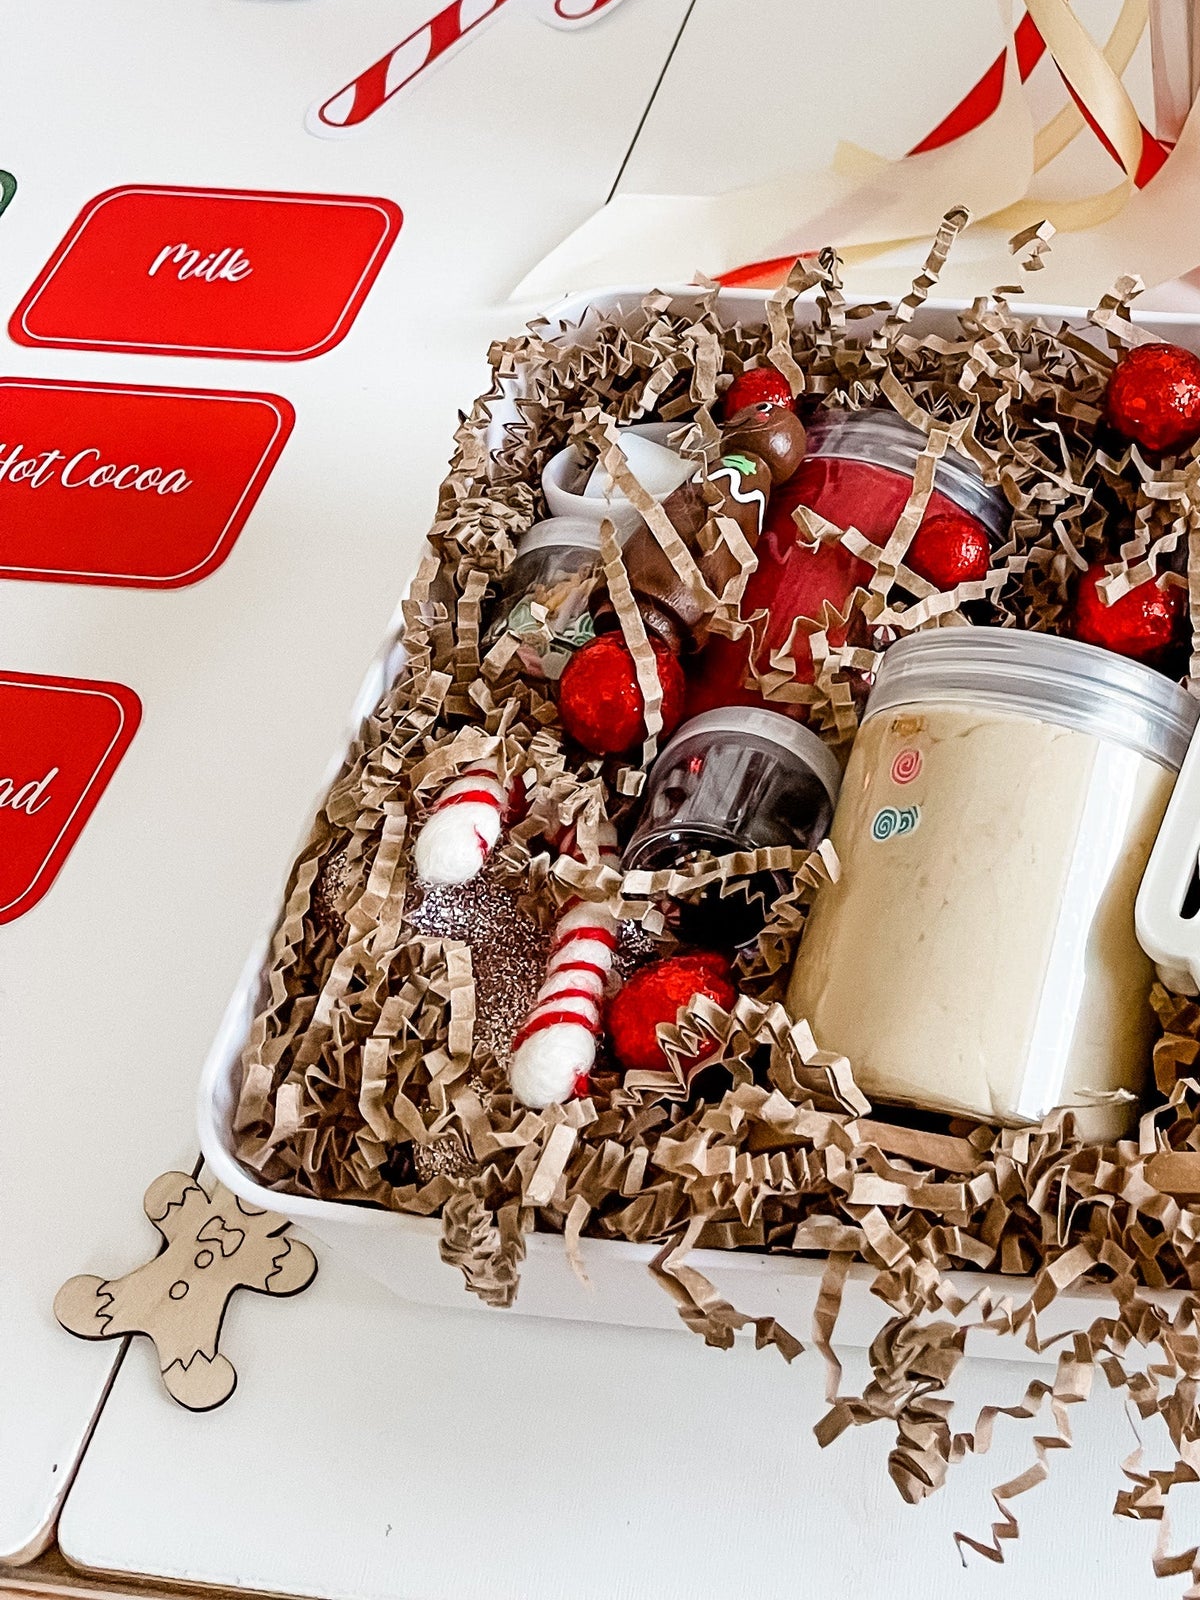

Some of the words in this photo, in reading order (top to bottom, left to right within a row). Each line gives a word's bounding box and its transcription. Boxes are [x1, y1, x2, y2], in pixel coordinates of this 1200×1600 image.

[148, 242, 253, 282] Milk
[0, 443, 66, 489] Hot
[61, 448, 193, 495] Cocoa
